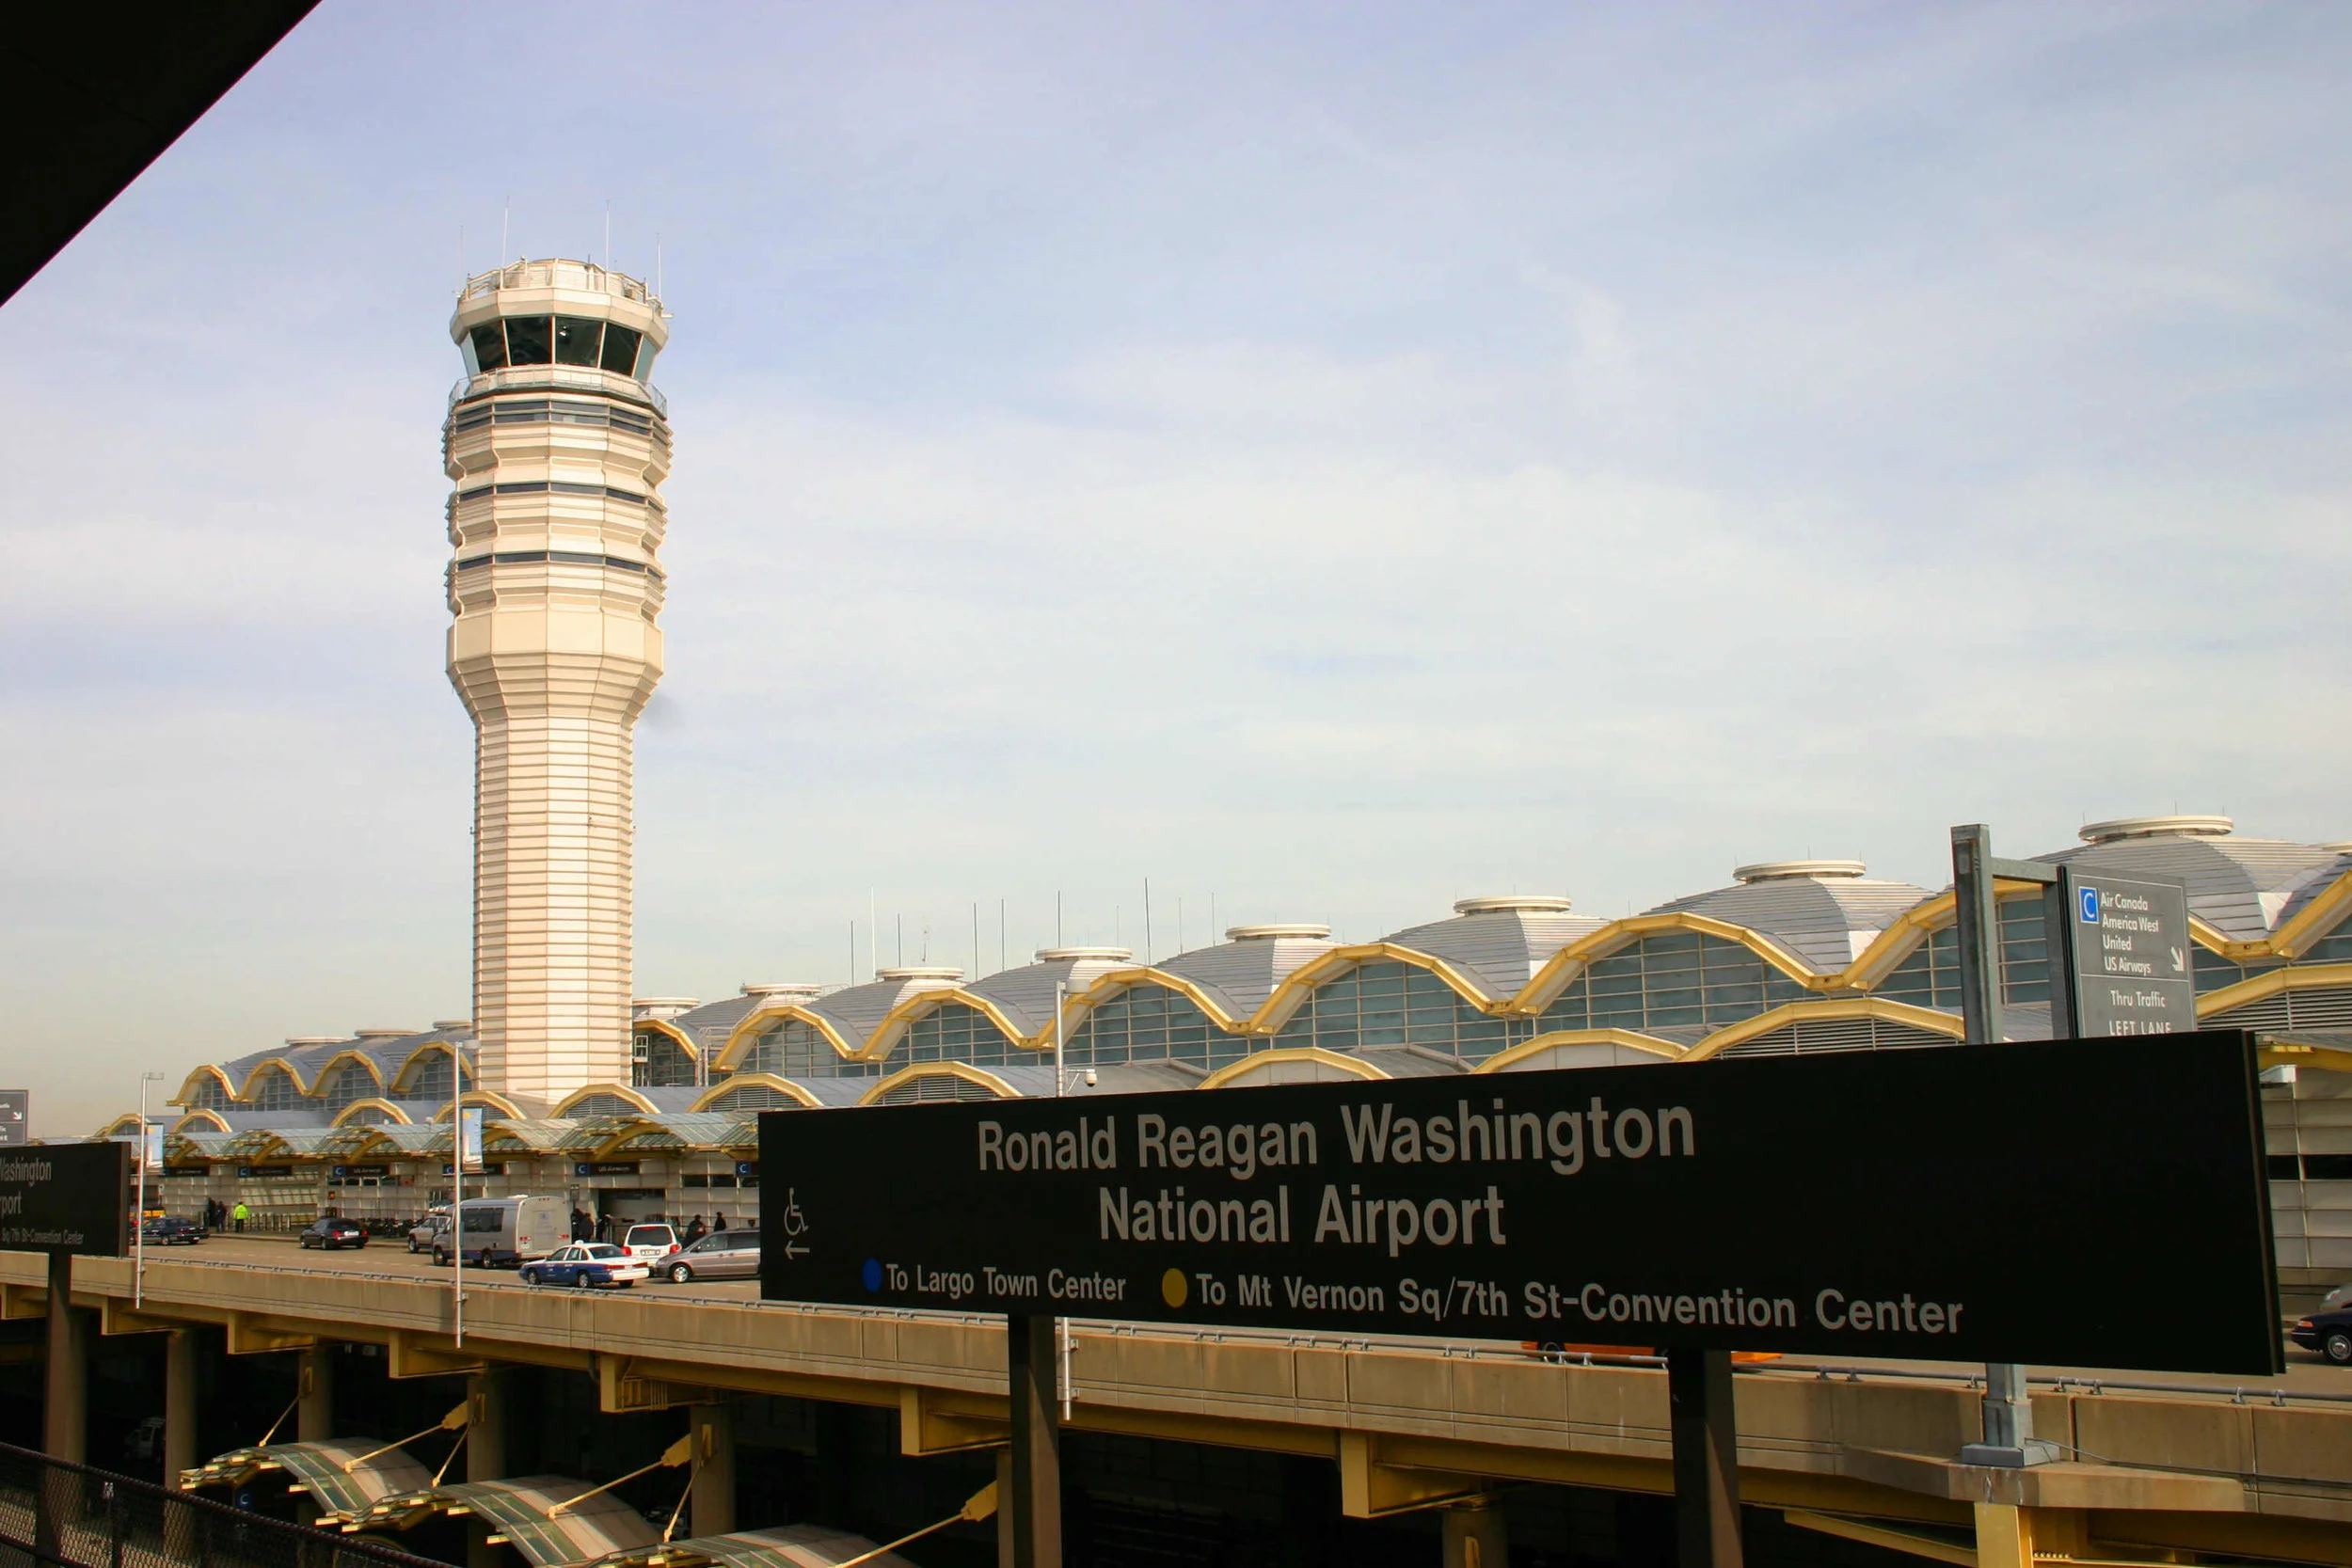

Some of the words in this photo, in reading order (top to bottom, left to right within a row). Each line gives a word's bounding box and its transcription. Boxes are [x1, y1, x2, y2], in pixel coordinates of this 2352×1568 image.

[2083, 892, 2096, 918] C
[2100, 893, 2114, 908] Air
[2115, 895, 2149, 911] Canada
[2102, 915, 2137, 931] America
[2138, 916, 2160, 932] West
[2103, 935, 2132, 951] United
[2105, 957, 2118, 972] US
[2119, 958, 2152, 976] Airways
[2110, 990, 2133, 1006] Thru
[2136, 990, 2166, 1008] Traffic
[2108, 1020, 2136, 1036] LEFT
[2140, 1021, 2171, 1035] LANE
[978, 1116, 1117, 1171] Ronald
[1137, 1113, 1317, 1180] Reagan
[1340, 1096, 1694, 1176] Washington
[1099, 1185, 1290, 1243] National
[1314, 1183, 1506, 1258] Airport
[886, 1263, 909, 1291] To
[917, 1265, 975, 1300] Largo
[983, 1267, 1039, 1297] Town
[1047, 1268, 1127, 1301] Center
[1196, 1273, 1226, 1306] To
[1238, 1275, 1273, 1307] Mt
[1283, 1276, 1385, 1312] Vernon
[1399, 1276, 1508, 1322] Sq/7th
[1524, 1281, 1796, 1327] St-Convention
[1815, 1288, 1963, 1334] Center
